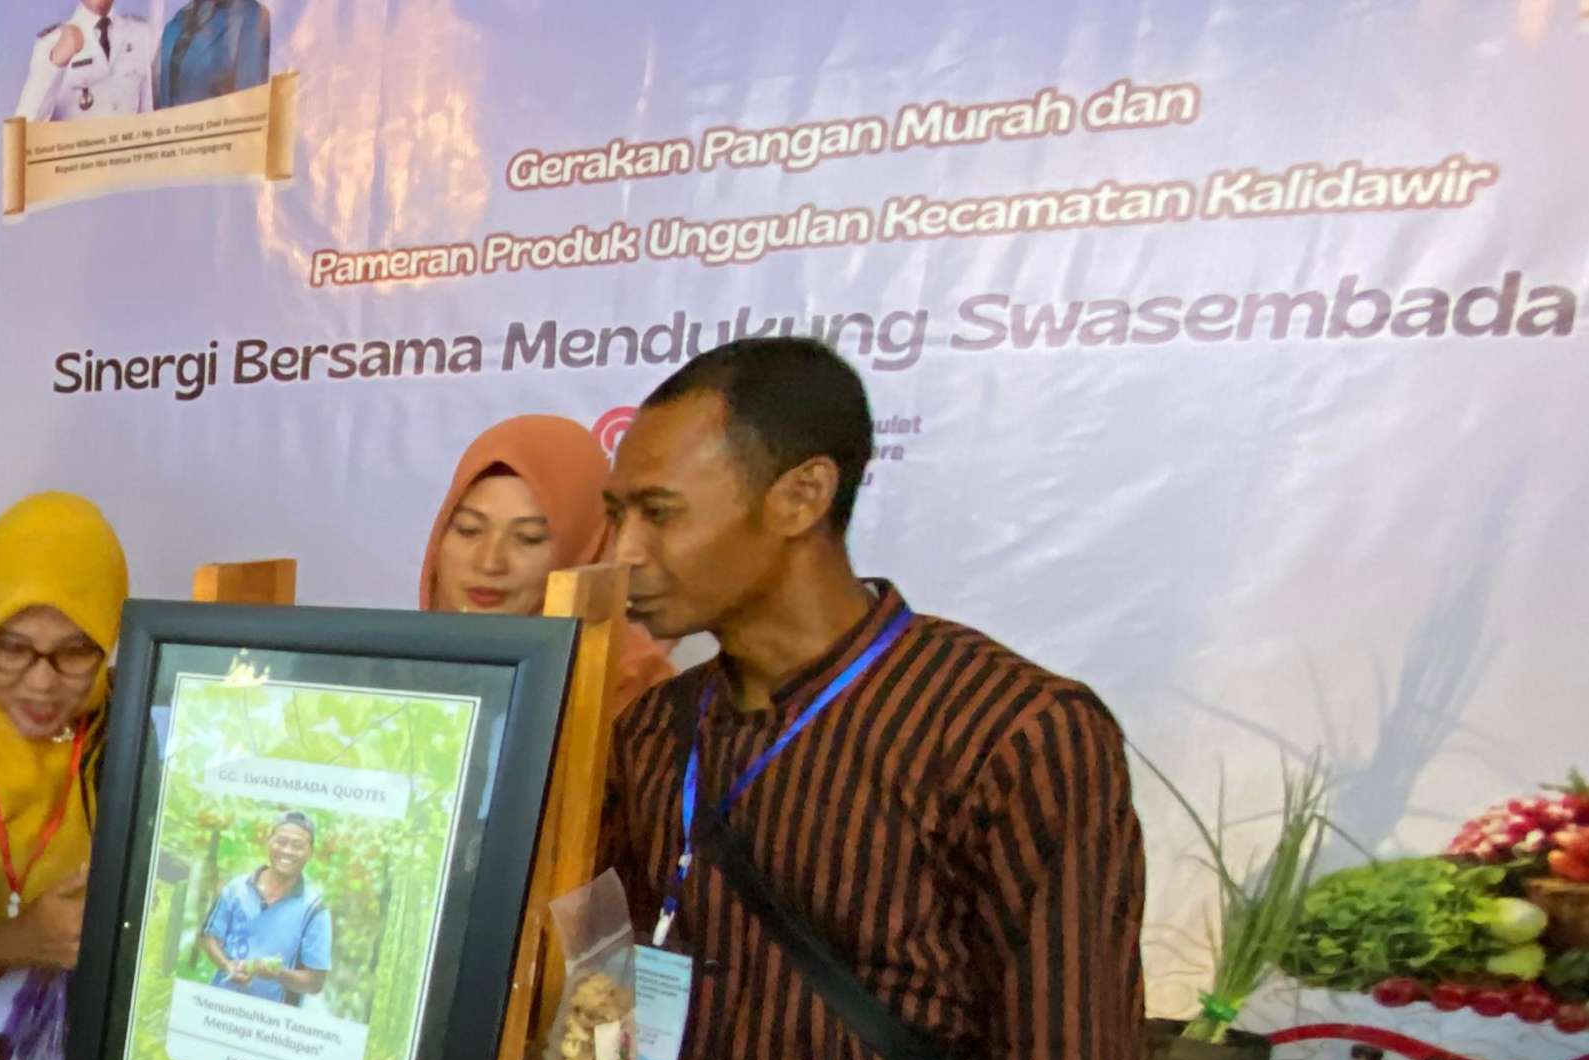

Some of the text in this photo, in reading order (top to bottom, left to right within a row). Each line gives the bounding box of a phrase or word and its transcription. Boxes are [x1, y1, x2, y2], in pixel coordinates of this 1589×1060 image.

[509, 79, 1200, 190] Gerakan Pangan Murah dan
[311, 155, 1498, 287] Pameran Produk Unggulan Kecamatan Kalidawir
[53, 340, 218, 401] Sinergi
[232, 336, 482, 384] Bersama
[950, 271, 1576, 351] Swasembada
[243, 773, 329, 795] SWASEMBADA
[332, 784, 387, 802] QUOTES
[203, 1016, 253, 1039] Menjaga
